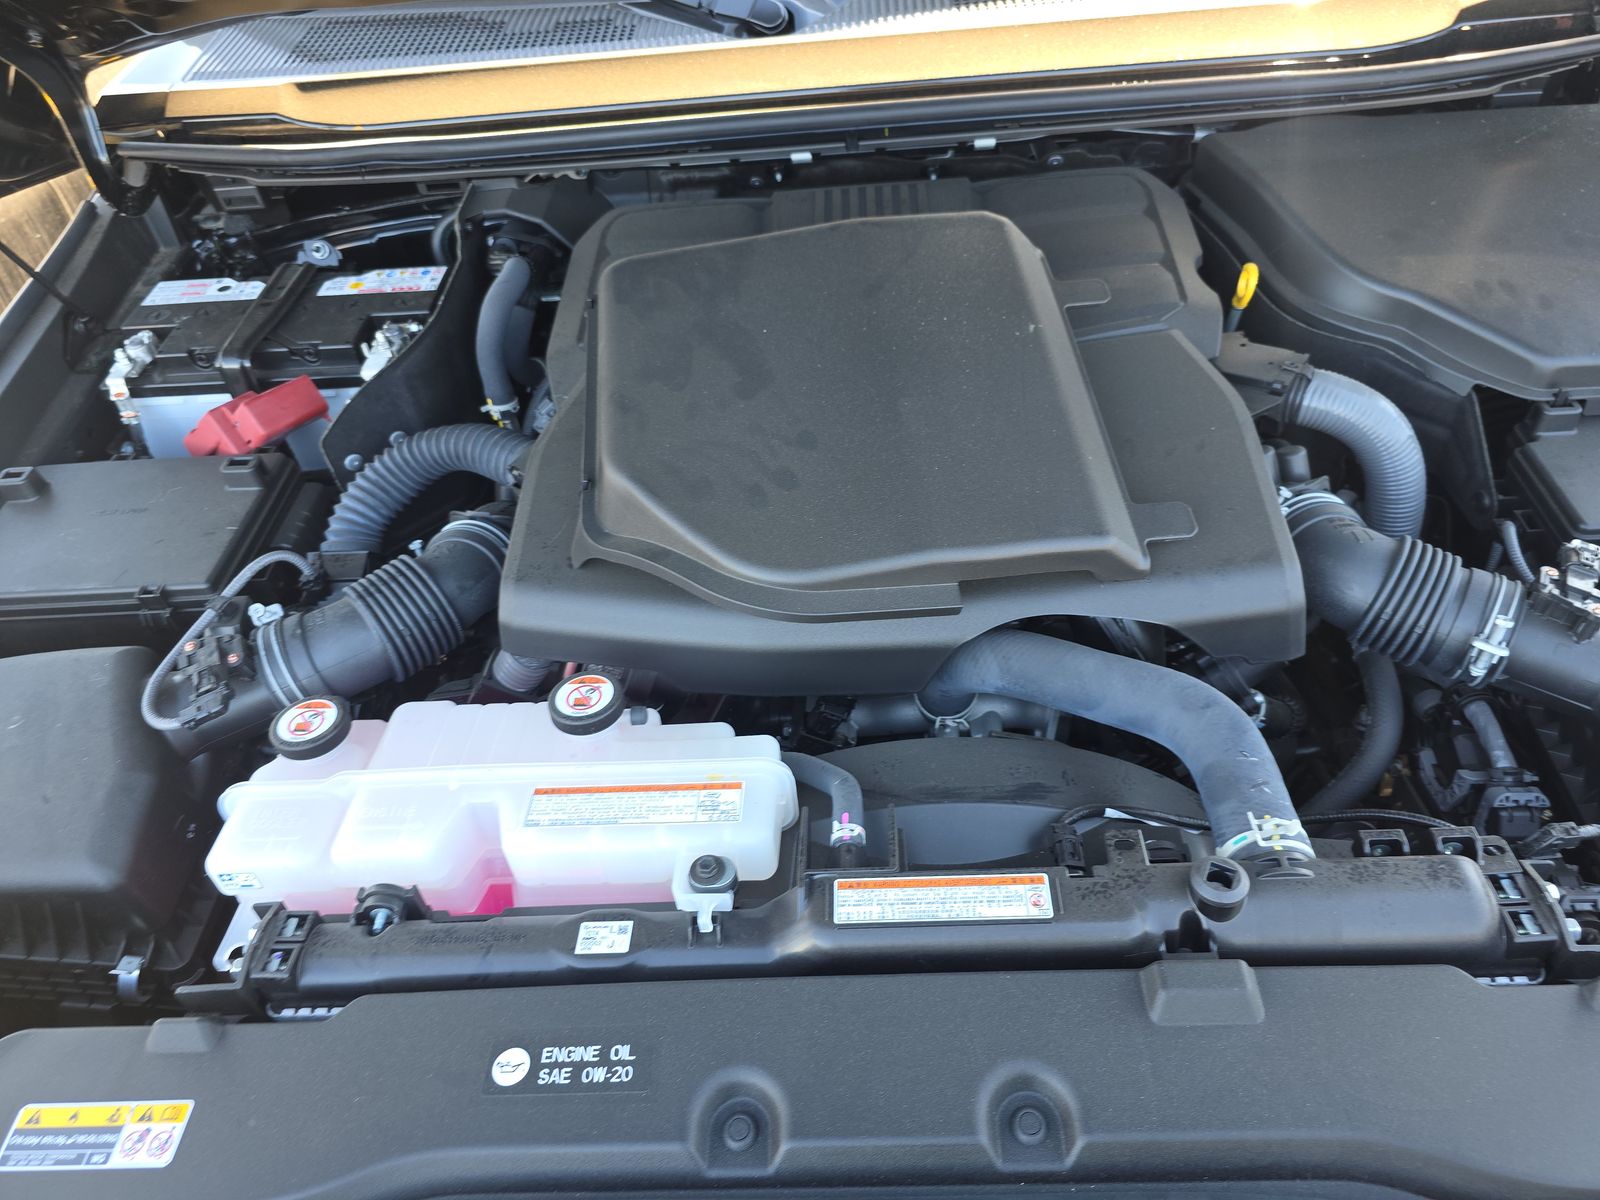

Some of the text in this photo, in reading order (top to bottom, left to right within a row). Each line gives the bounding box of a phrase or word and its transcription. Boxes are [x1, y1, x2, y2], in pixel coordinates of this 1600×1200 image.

[541, 1045, 636, 1063] ENGINE OIL
[538, 1066, 633, 1084] SAE 0W-20
